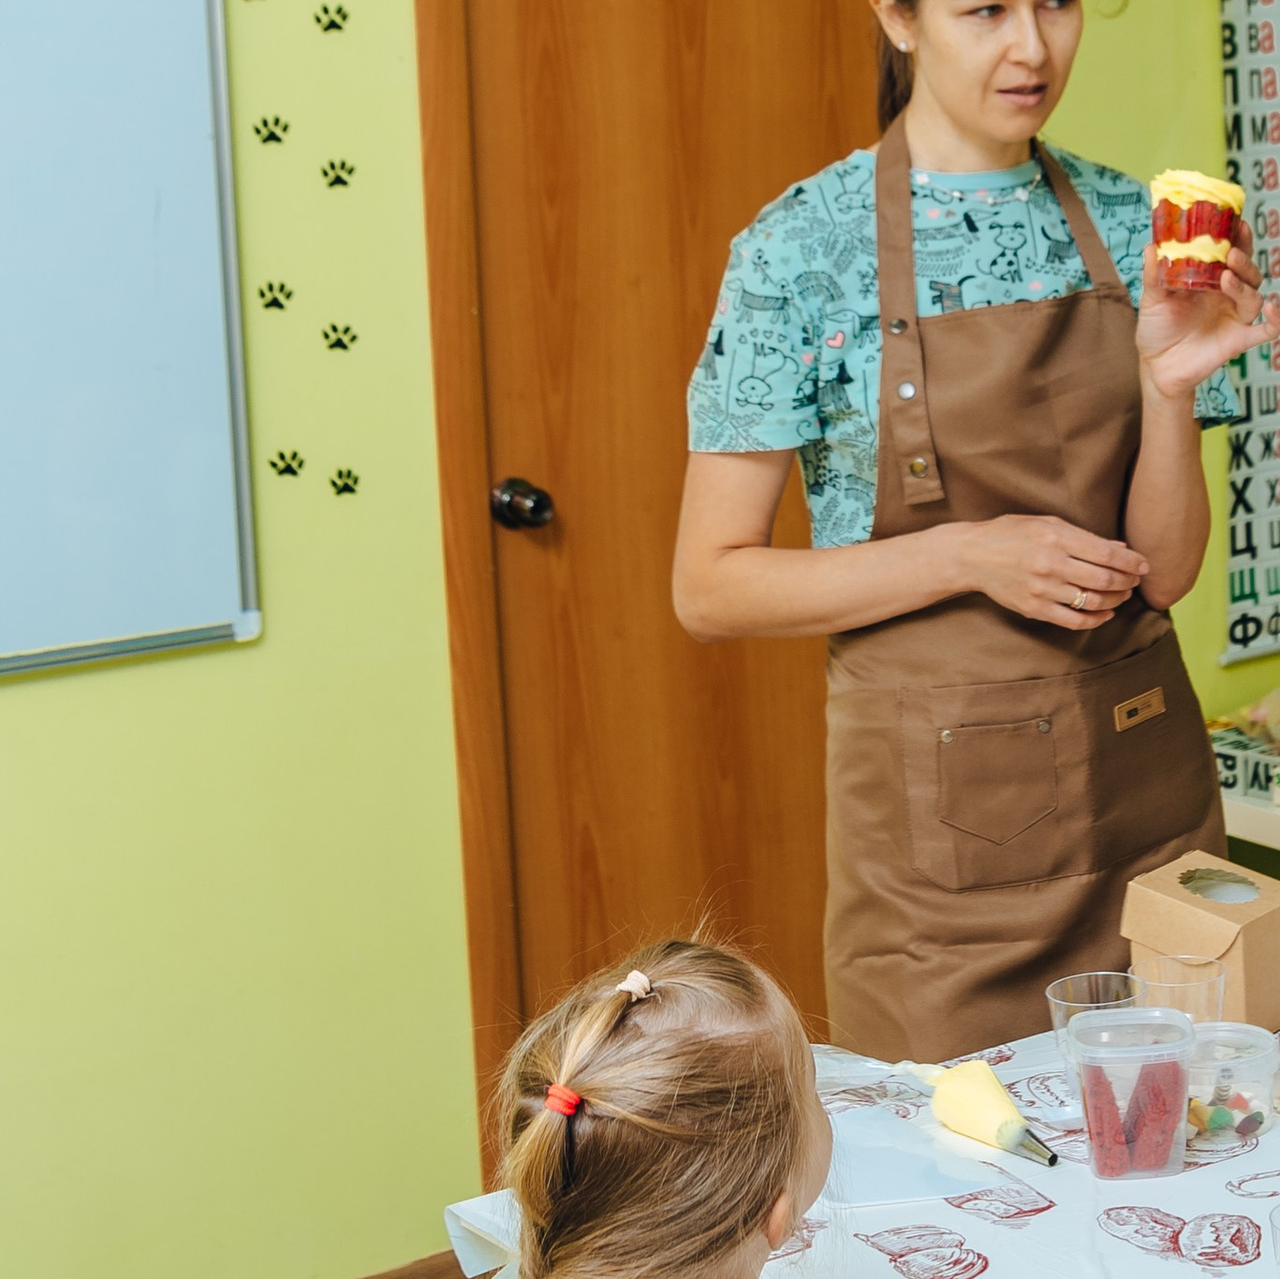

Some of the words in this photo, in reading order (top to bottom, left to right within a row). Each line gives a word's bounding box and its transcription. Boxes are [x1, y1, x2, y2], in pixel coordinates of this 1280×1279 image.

[1221, 23, 1237, 60] В
[1248, 21, 1275, 54] ва
[1249, 67, 1278, 100] па
[1253, 158, 1279, 191] за
[1254, 201, 1280, 239] ба
[1229, 431, 1254, 470] Ж
[1230, 477, 1254, 517] Х
[1230, 522, 1257, 559] Ц
[1229, 613, 1263, 648] Ф
